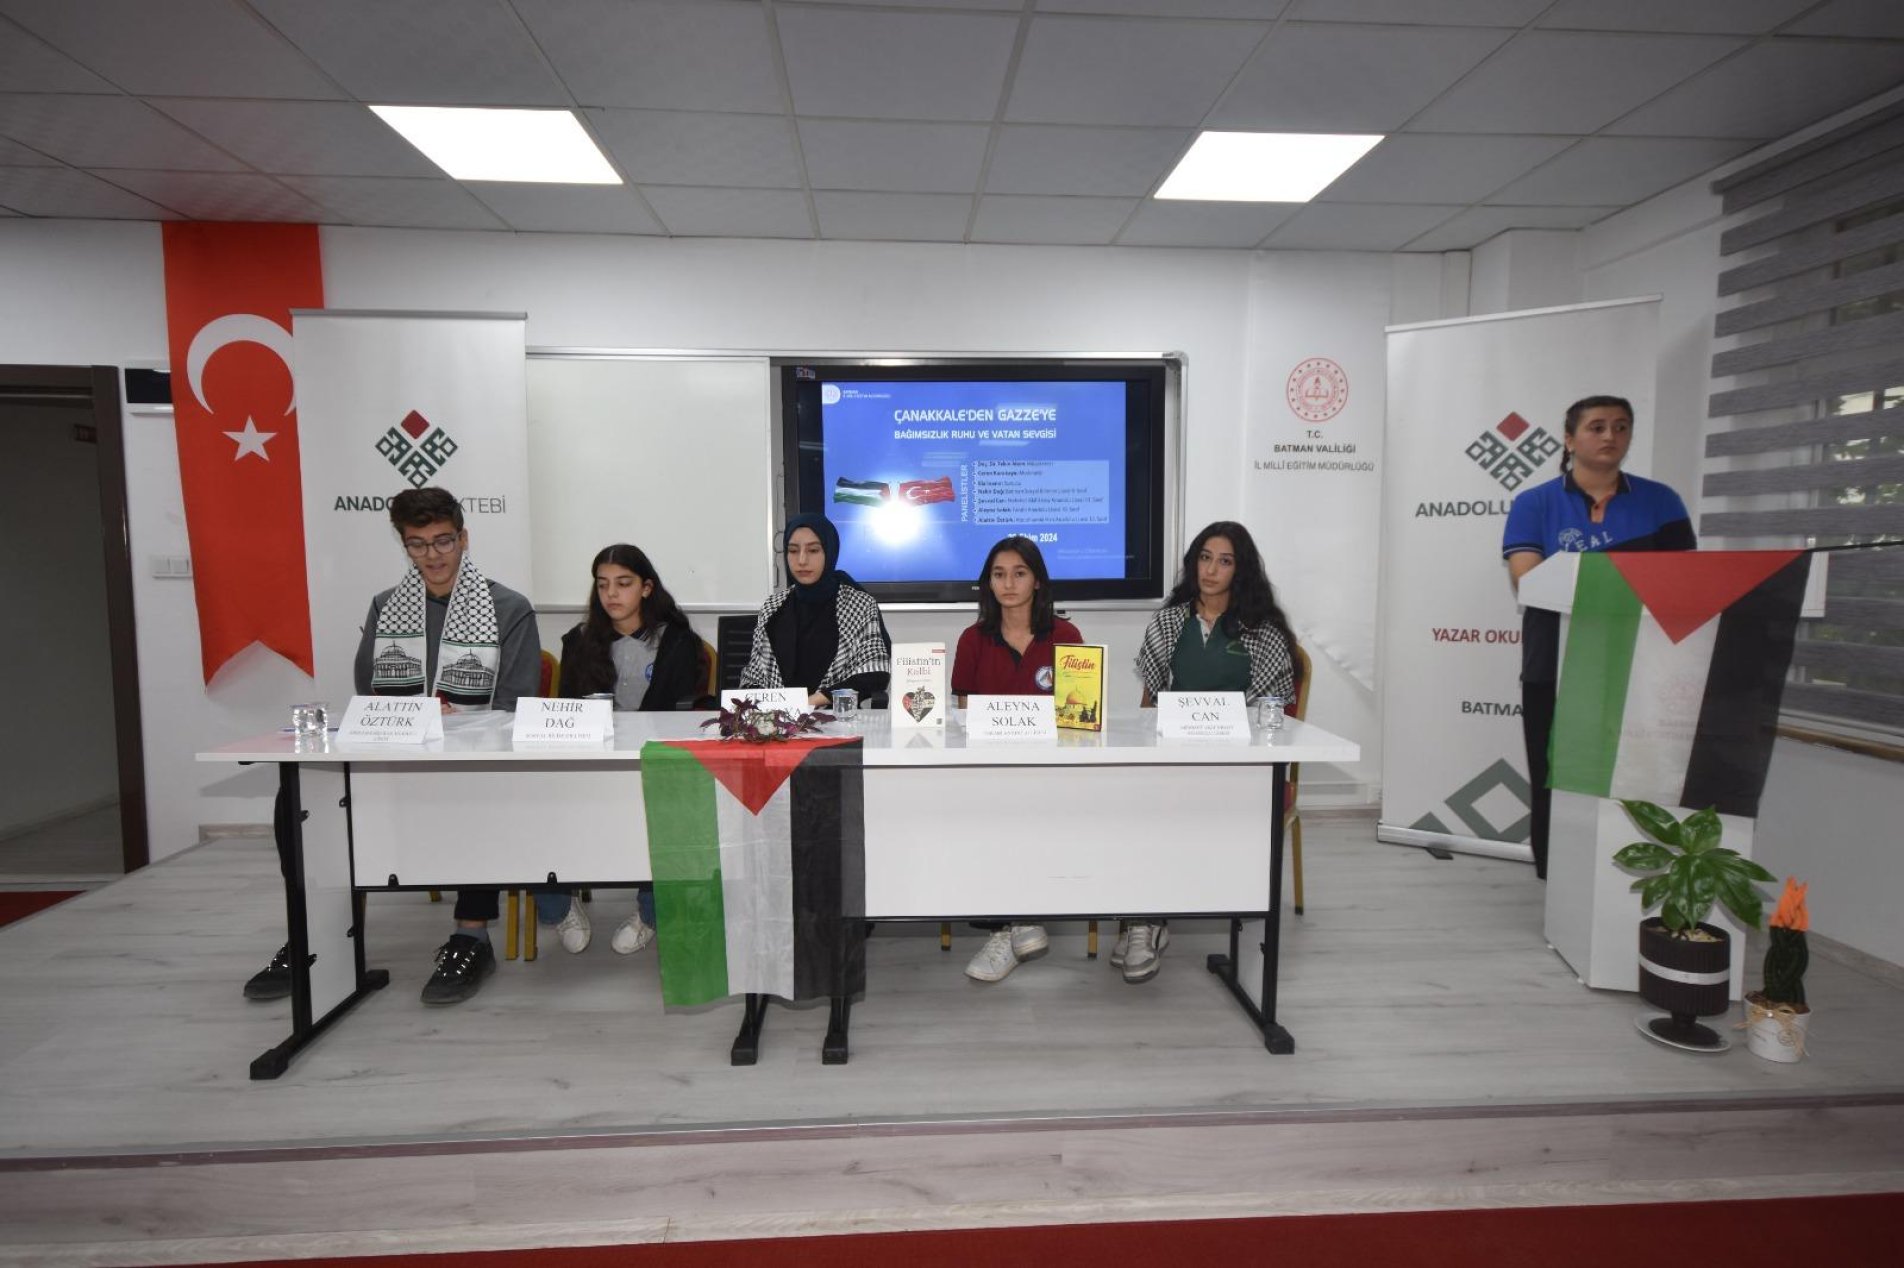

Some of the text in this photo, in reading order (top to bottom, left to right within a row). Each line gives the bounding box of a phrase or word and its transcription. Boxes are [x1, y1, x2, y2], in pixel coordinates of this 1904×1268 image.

[894, 409, 1057, 424] ÇANAKKALE'DEN GAZZE'YE
[951, 430, 976, 439] RUHU
[978, 430, 989, 438] VE
[992, 430, 1020, 438] VATAN
[1273, 444, 1313, 453] BATMAN
[334, 494, 506, 514] ANAD KTEBİ
[1415, 500, 1514, 517] ANADOLU
[1040, 532, 1058, 542] 2024
[1432, 627, 1522, 644] YAZAR OKU
[987, 701, 1040, 711] ALEYNA
[1461, 701, 1524, 717] BATMA
[992, 716, 1037, 727] SOLAK
[1191, 712, 1220, 721] CAN
